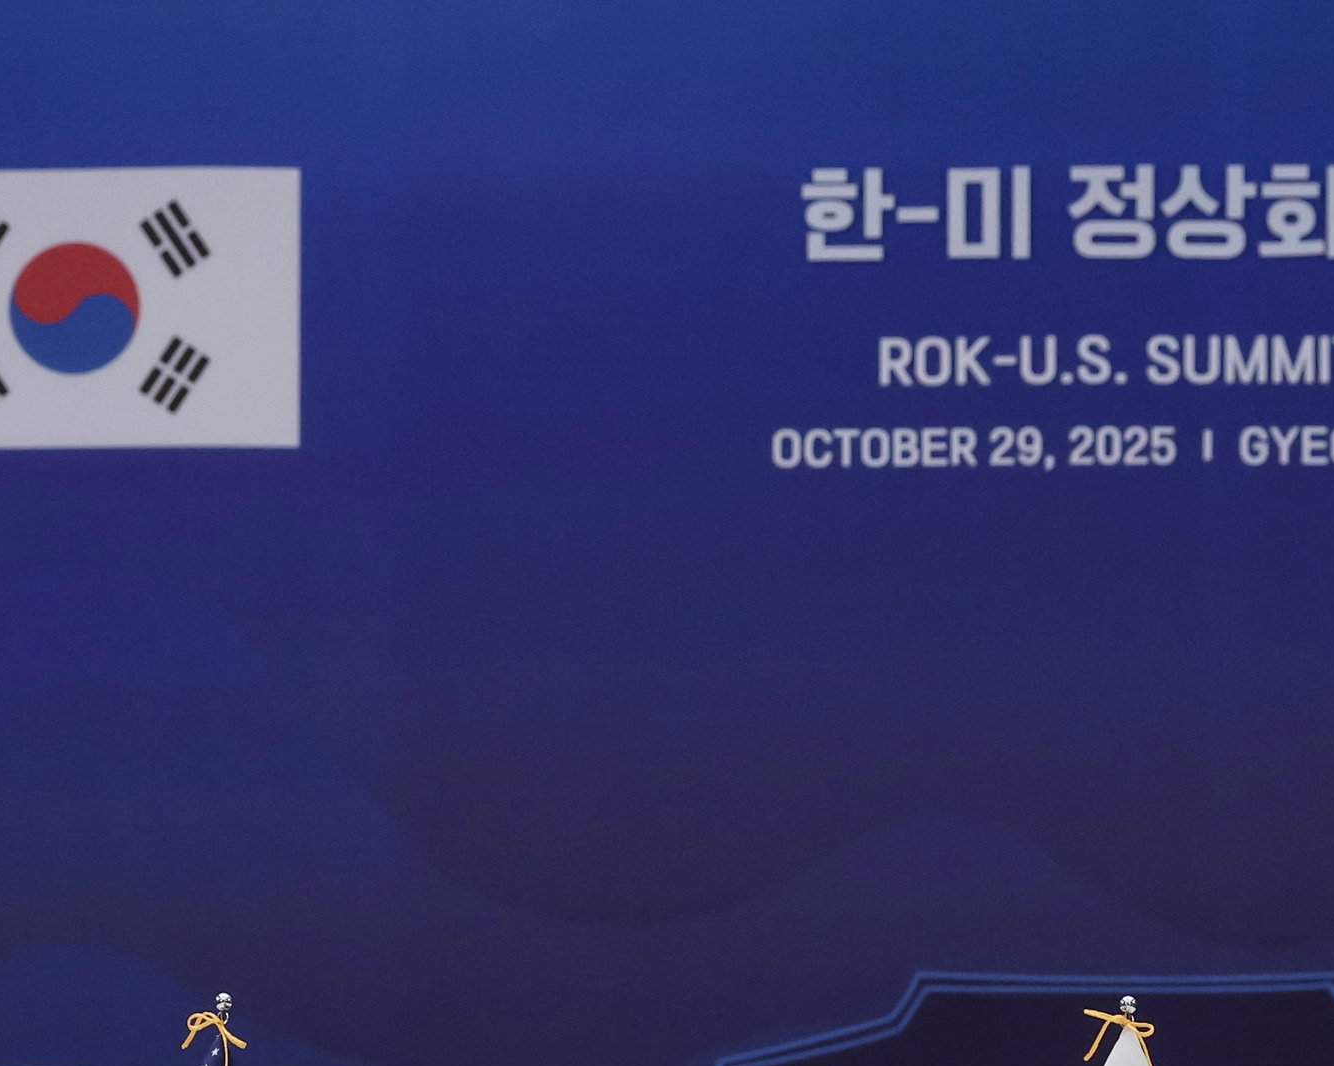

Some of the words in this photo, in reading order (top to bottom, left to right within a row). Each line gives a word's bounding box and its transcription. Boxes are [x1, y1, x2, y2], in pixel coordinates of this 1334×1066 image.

[800, 165, 1033, 261] 한-미
[878, 333, 1128, 386] ROK-U.S.
[771, 426, 978, 468] OCTOBER
[989, 425, 1056, 471] 29,
[1068, 424, 1177, 466] 2025
